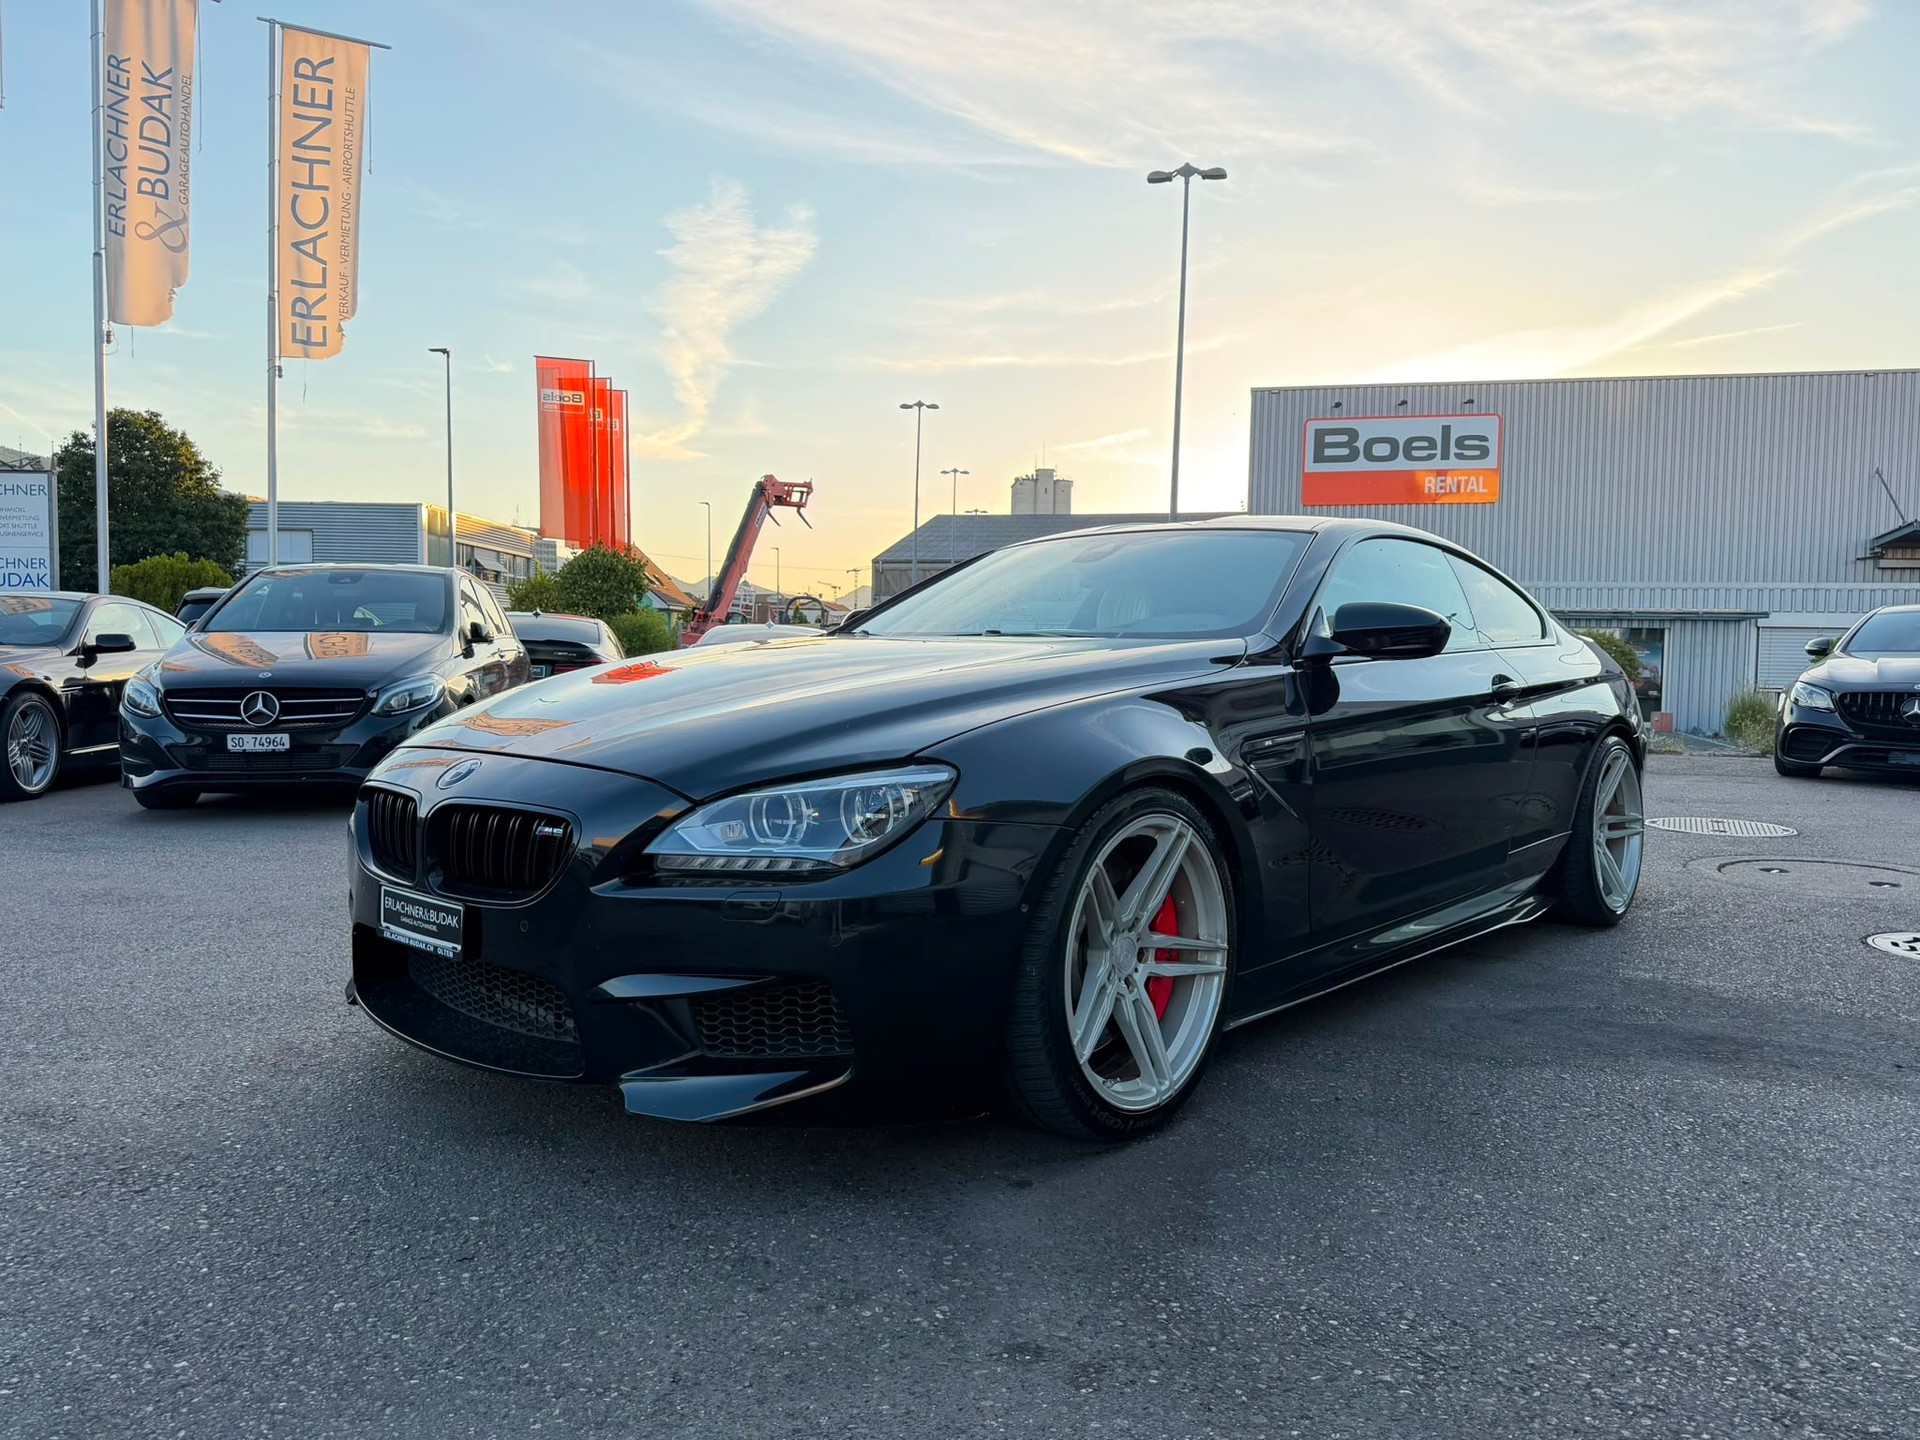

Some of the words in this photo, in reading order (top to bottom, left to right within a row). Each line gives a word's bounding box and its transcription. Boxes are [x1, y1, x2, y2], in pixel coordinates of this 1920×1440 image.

[106, 53, 131, 238] ERLACHNER
[136, 58, 174, 201] BUDAK
[289, 55, 335, 348] ERLACHNER
[339, 192, 353, 265] VERMIETUNG
[339, 271, 350, 321] VERKAUF
[1313, 424, 1490, 464] Boels
[0, 483, 47, 496] HNER
[1424, 475, 1488, 494] RENTAL
